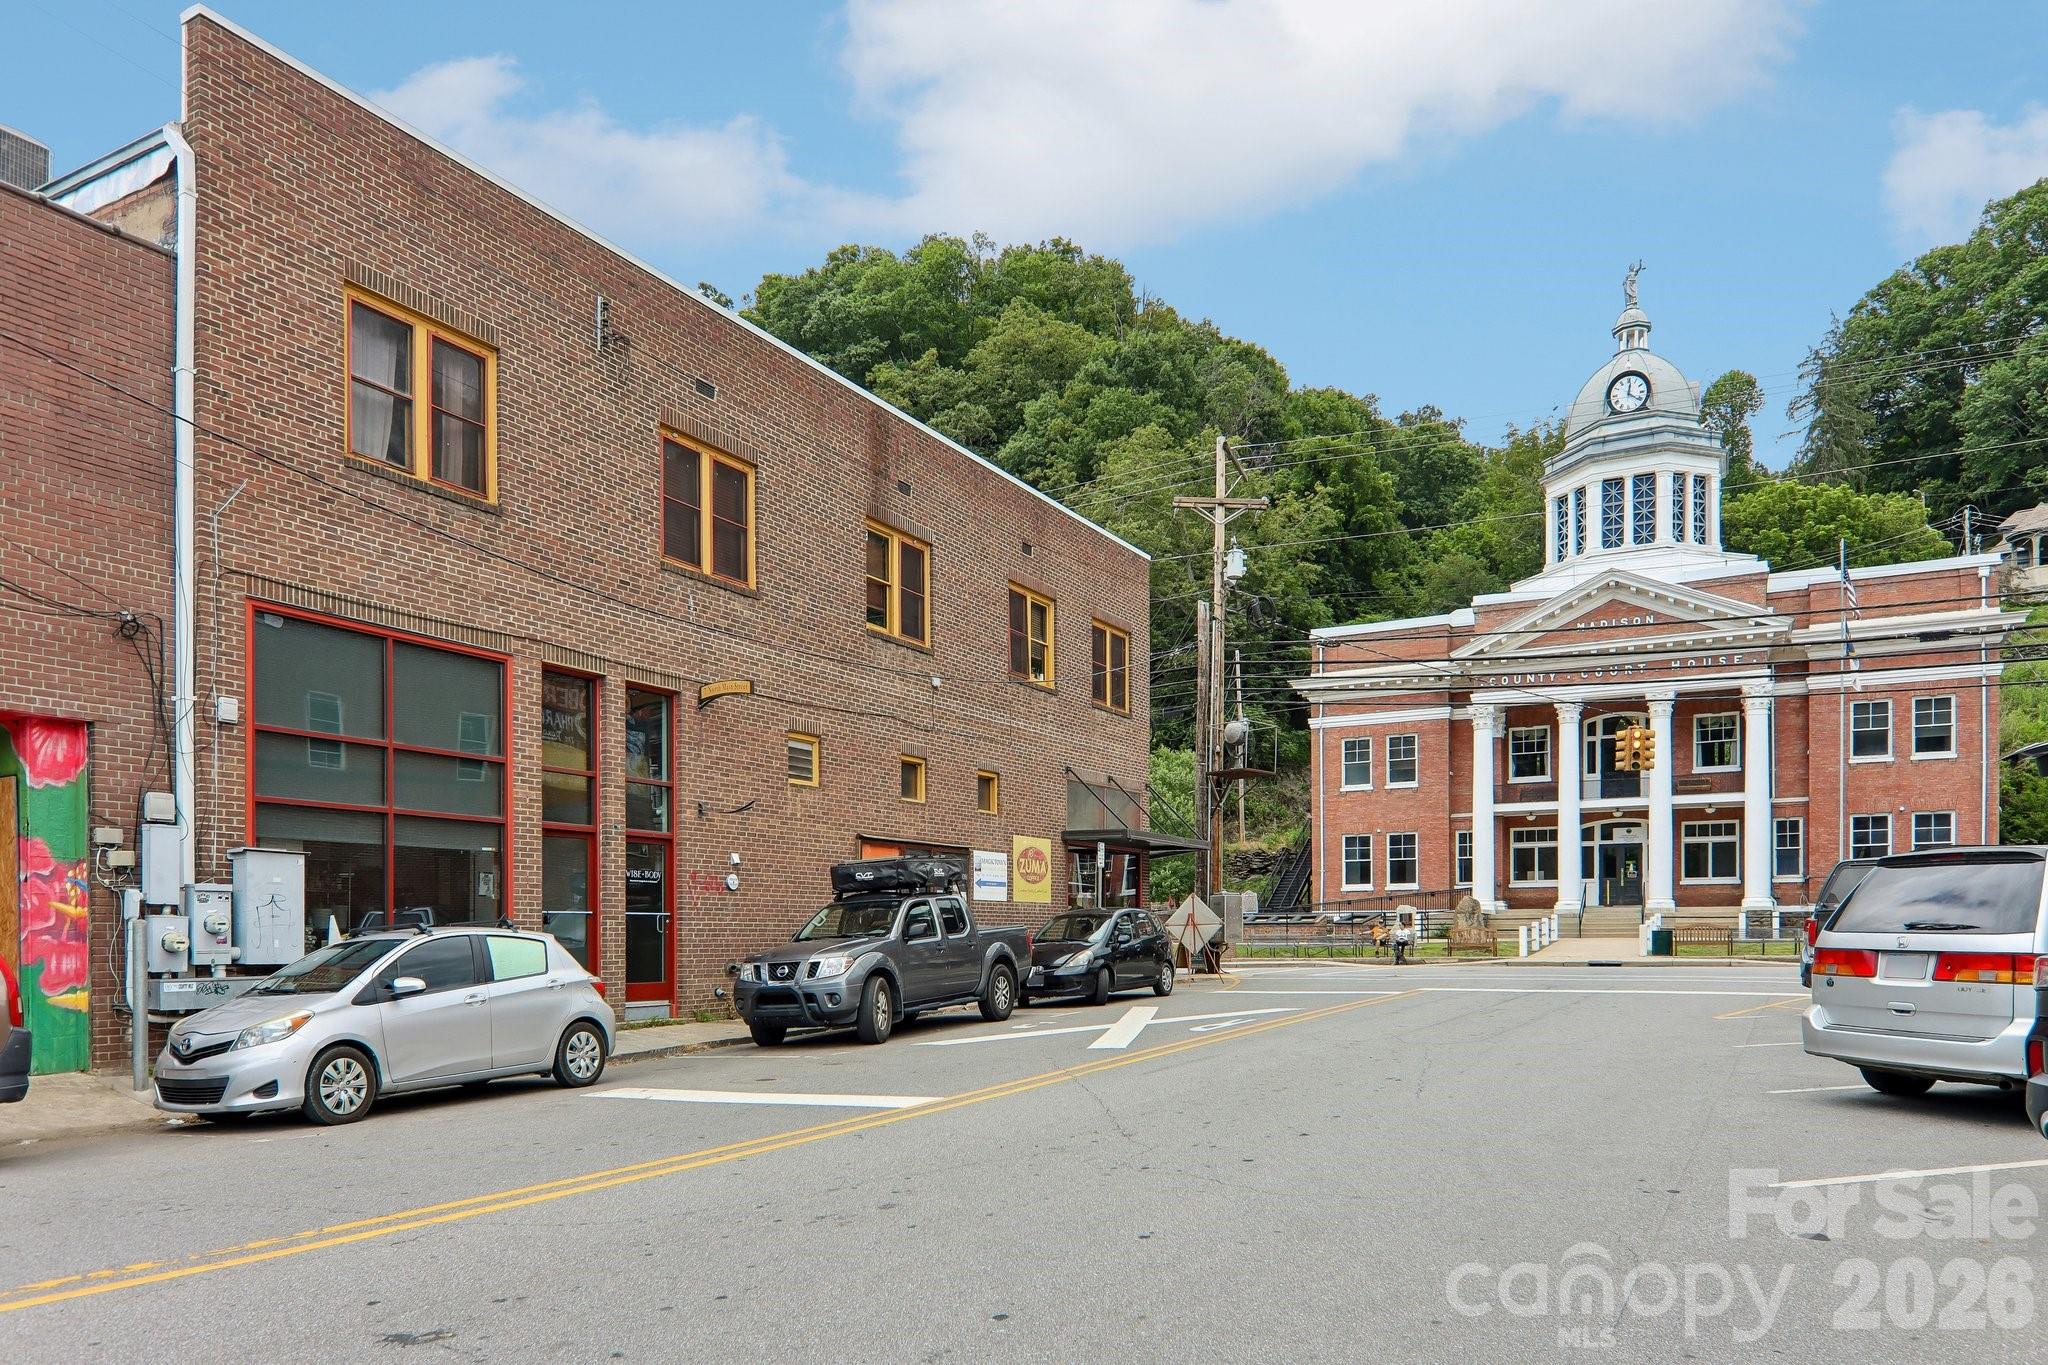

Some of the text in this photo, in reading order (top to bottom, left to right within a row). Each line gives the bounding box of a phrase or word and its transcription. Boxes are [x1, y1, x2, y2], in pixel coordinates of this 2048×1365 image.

[1576, 615, 1655, 632] MADISON
[1489, 655, 1743, 687] COUNTY COURT HOUSE
[1019, 858, 1047, 874] ZUMA
